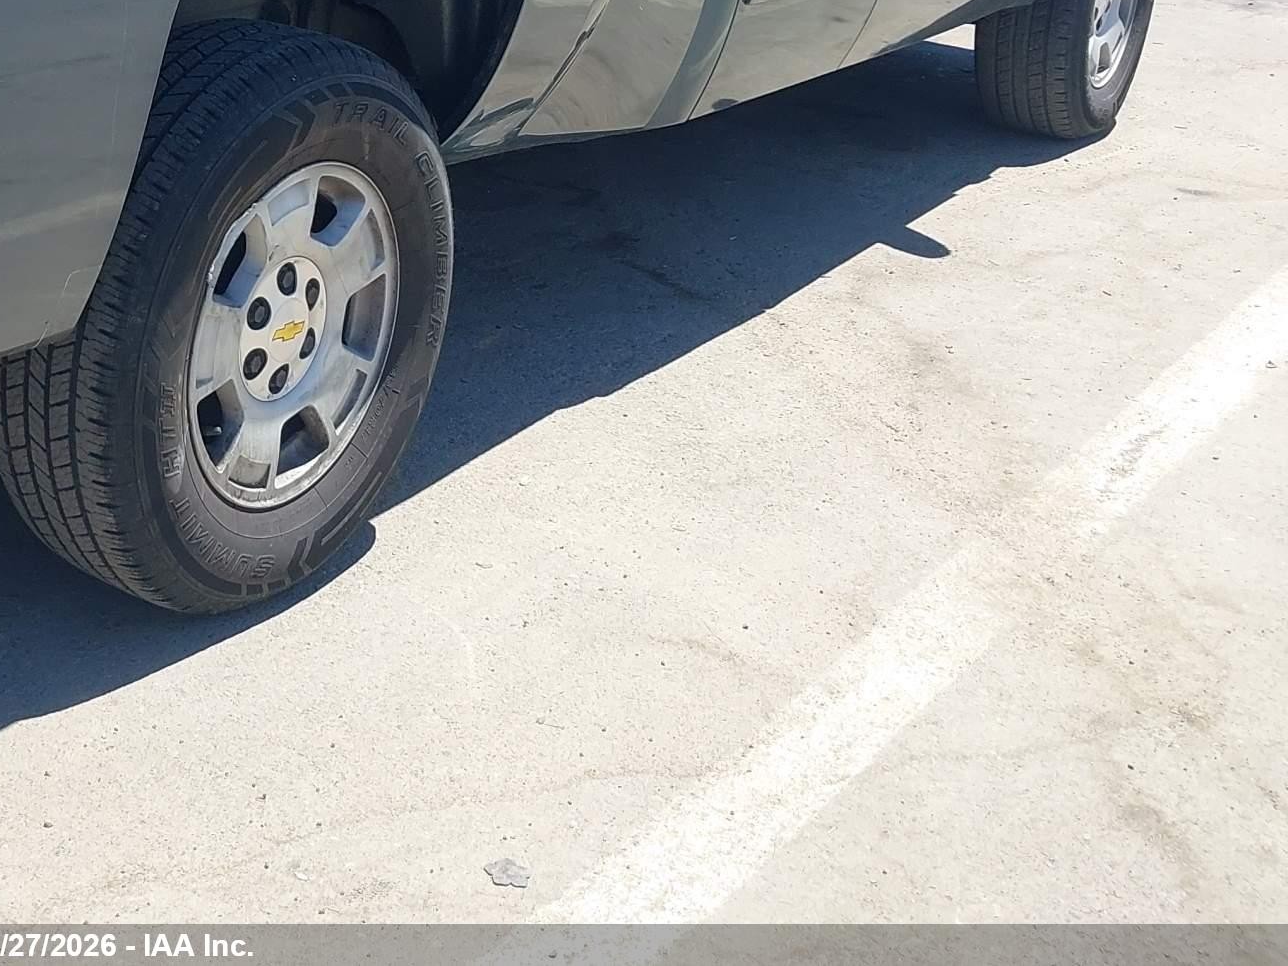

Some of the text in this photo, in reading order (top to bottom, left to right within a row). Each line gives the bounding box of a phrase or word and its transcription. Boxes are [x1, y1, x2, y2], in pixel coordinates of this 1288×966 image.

[332, 101, 450, 350] TRAIL CLIMBER
[168, 495, 277, 580] SUMMIT
